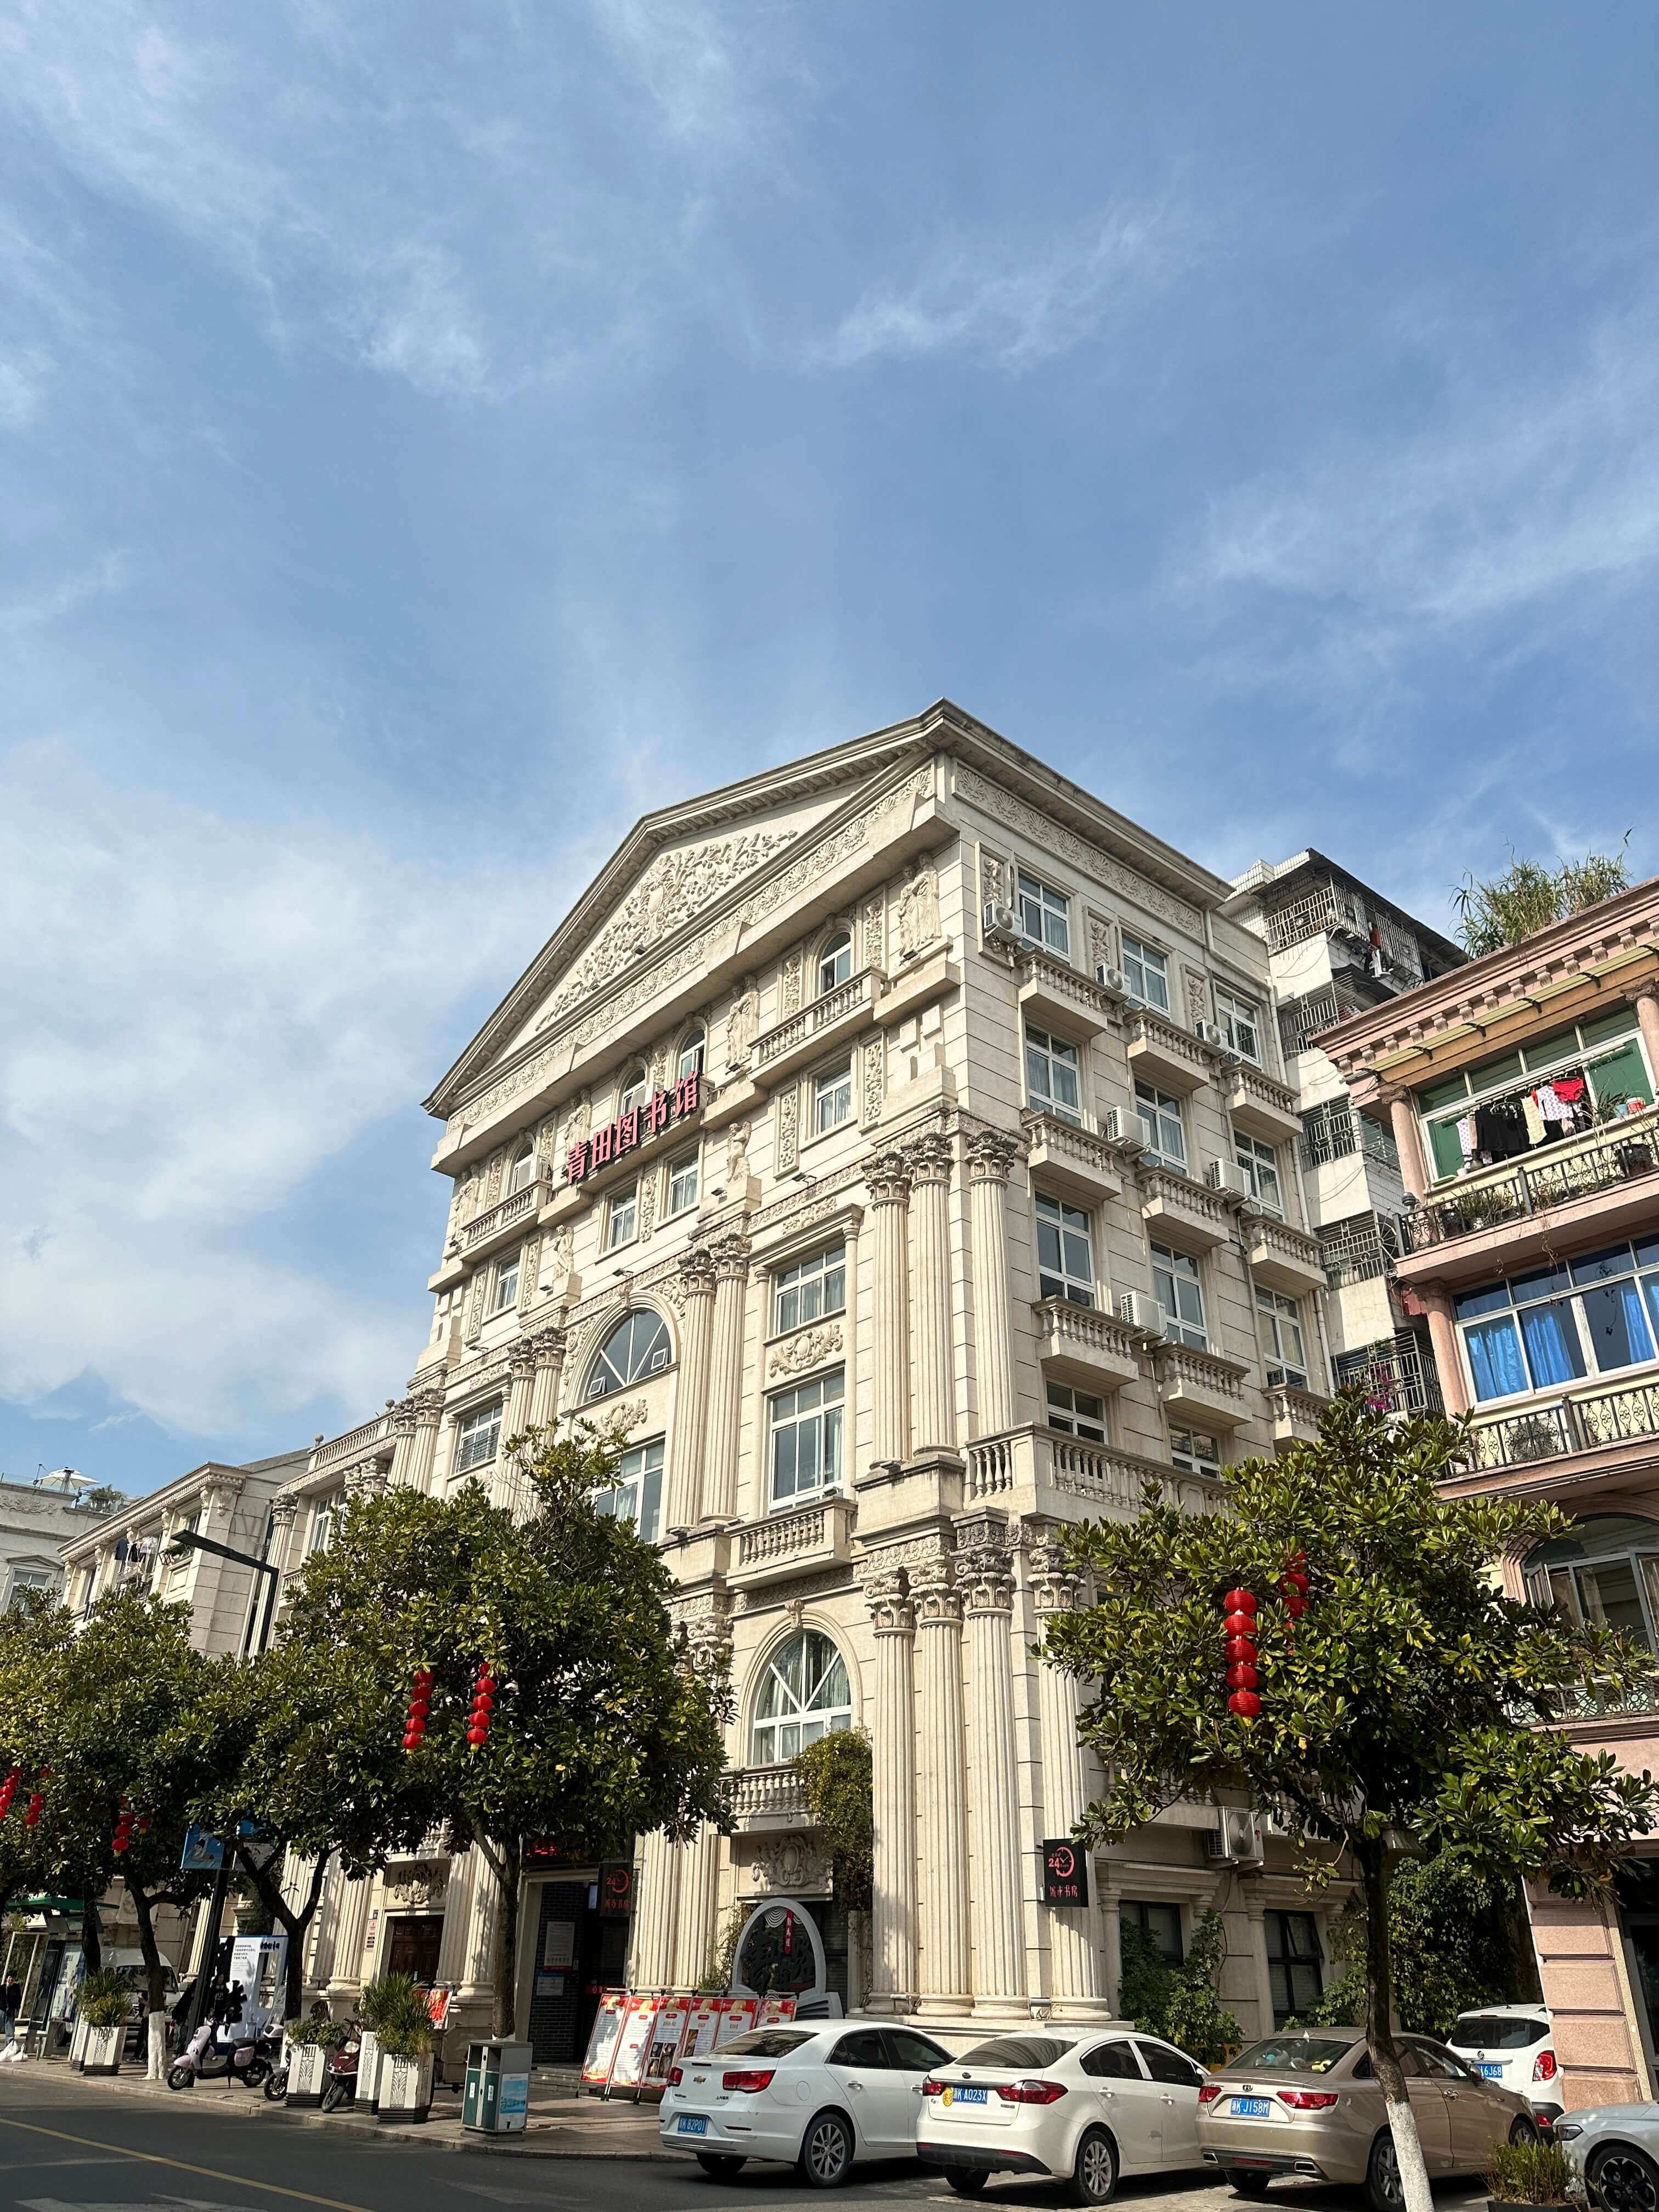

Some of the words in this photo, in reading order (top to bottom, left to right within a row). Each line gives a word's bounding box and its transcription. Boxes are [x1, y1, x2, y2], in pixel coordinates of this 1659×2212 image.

[568, 1071, 701, 1184] 青田图书馆
[1048, 1858, 1060, 1869] 24
